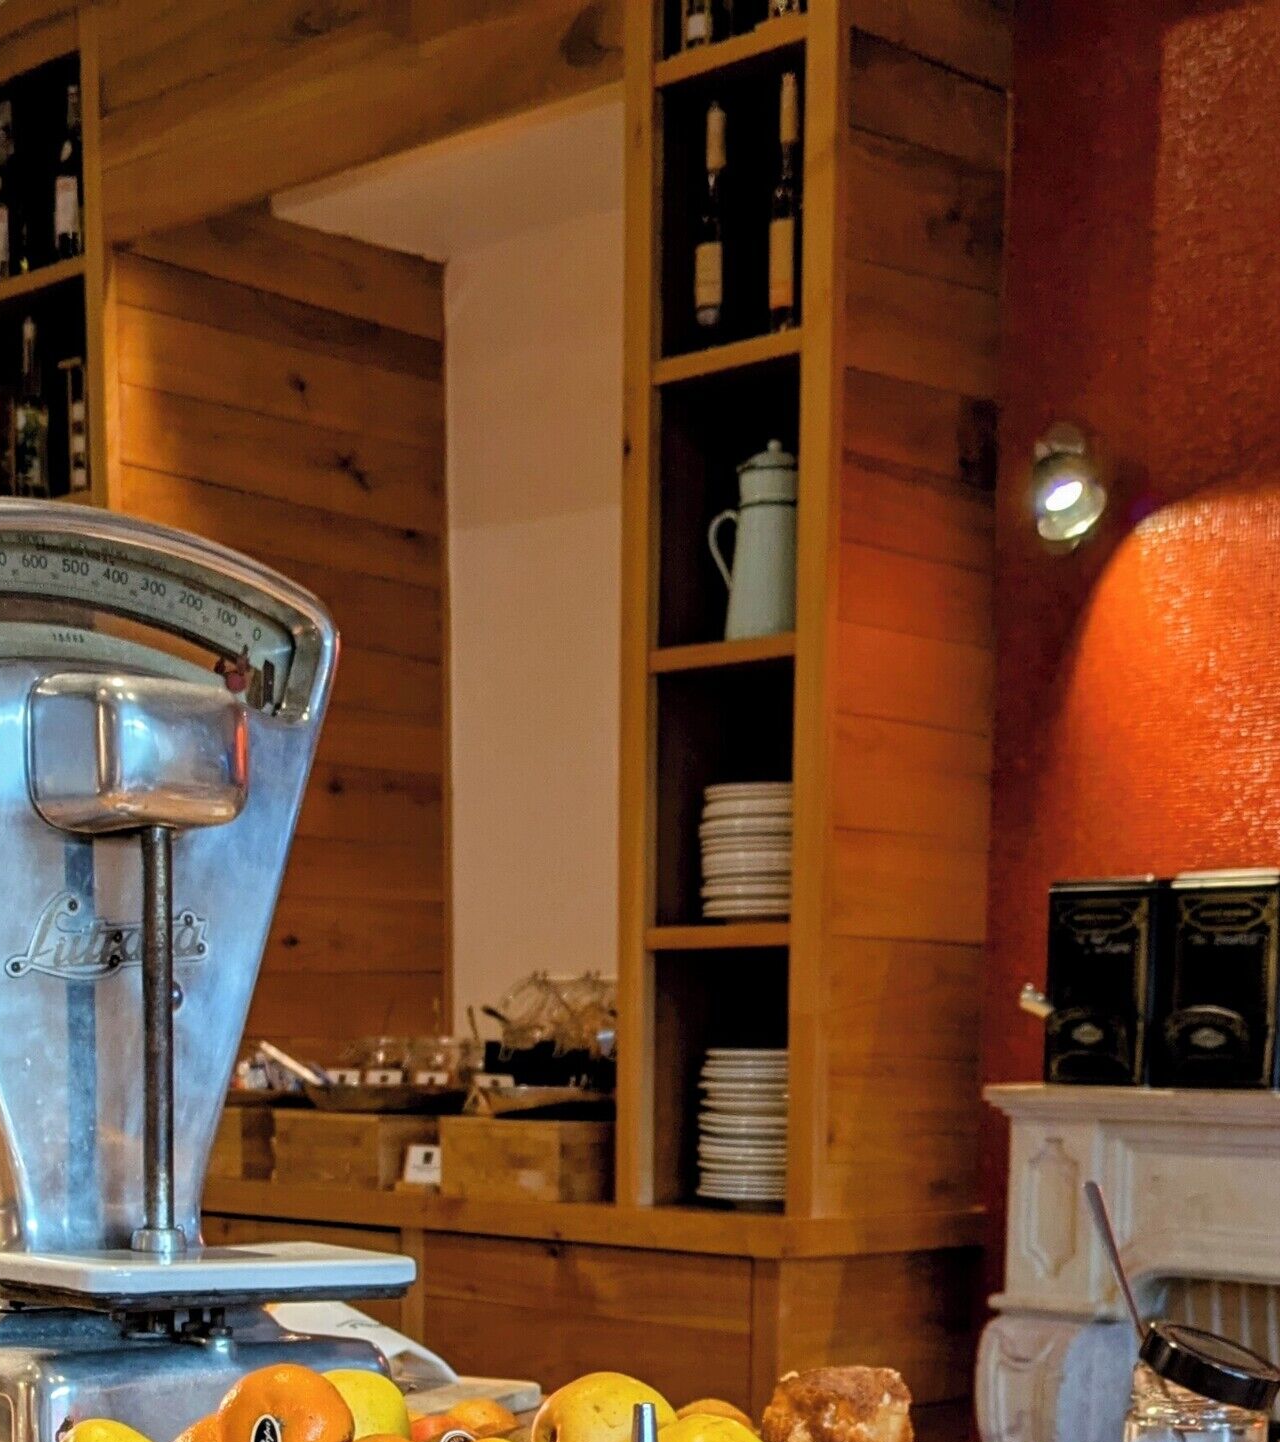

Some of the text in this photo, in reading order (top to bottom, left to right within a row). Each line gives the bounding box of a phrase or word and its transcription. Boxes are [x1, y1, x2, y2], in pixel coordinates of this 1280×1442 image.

[22, 554, 48, 570] 600
[62, 557, 89, 576] 500
[103, 567, 129, 586] 400
[140, 578, 166, 598] 300
[179, 590, 203, 612] 200
[217, 607, 238, 628] 100
[253, 627, 261, 642] 0
